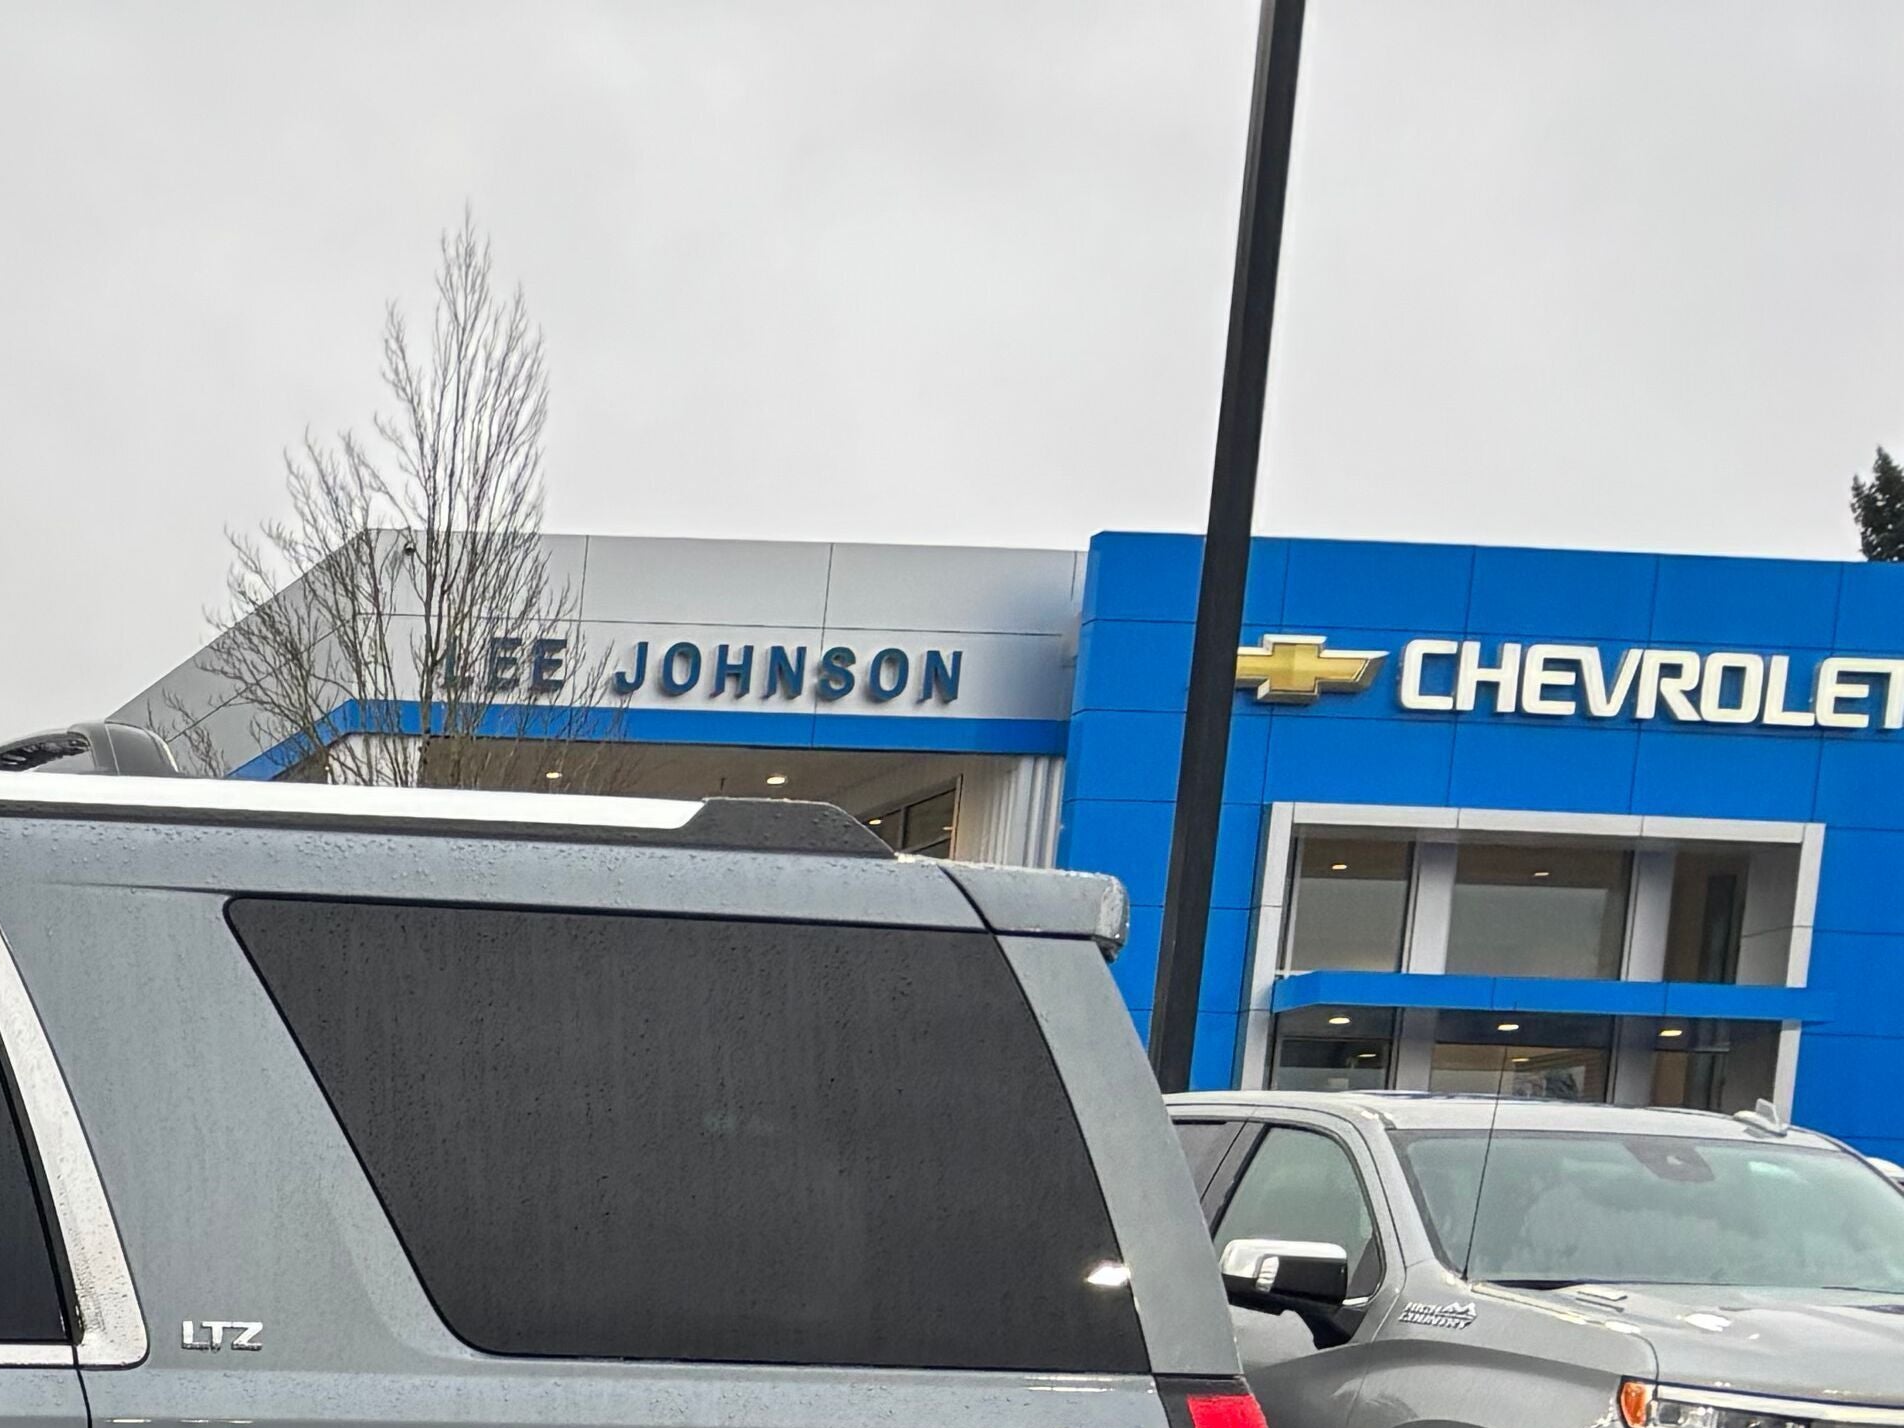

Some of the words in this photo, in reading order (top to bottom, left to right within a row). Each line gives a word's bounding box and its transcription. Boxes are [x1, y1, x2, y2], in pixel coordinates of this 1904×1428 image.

[442, 637, 569, 696] LEE
[613, 640, 963, 704] JOHNSON
[1399, 638, 1904, 730] CHEVROLET
[1397, 1311, 1473, 1330] COUNTRY
[1404, 1301, 1444, 1315] HIGH
[182, 1320, 264, 1352] LTZ
